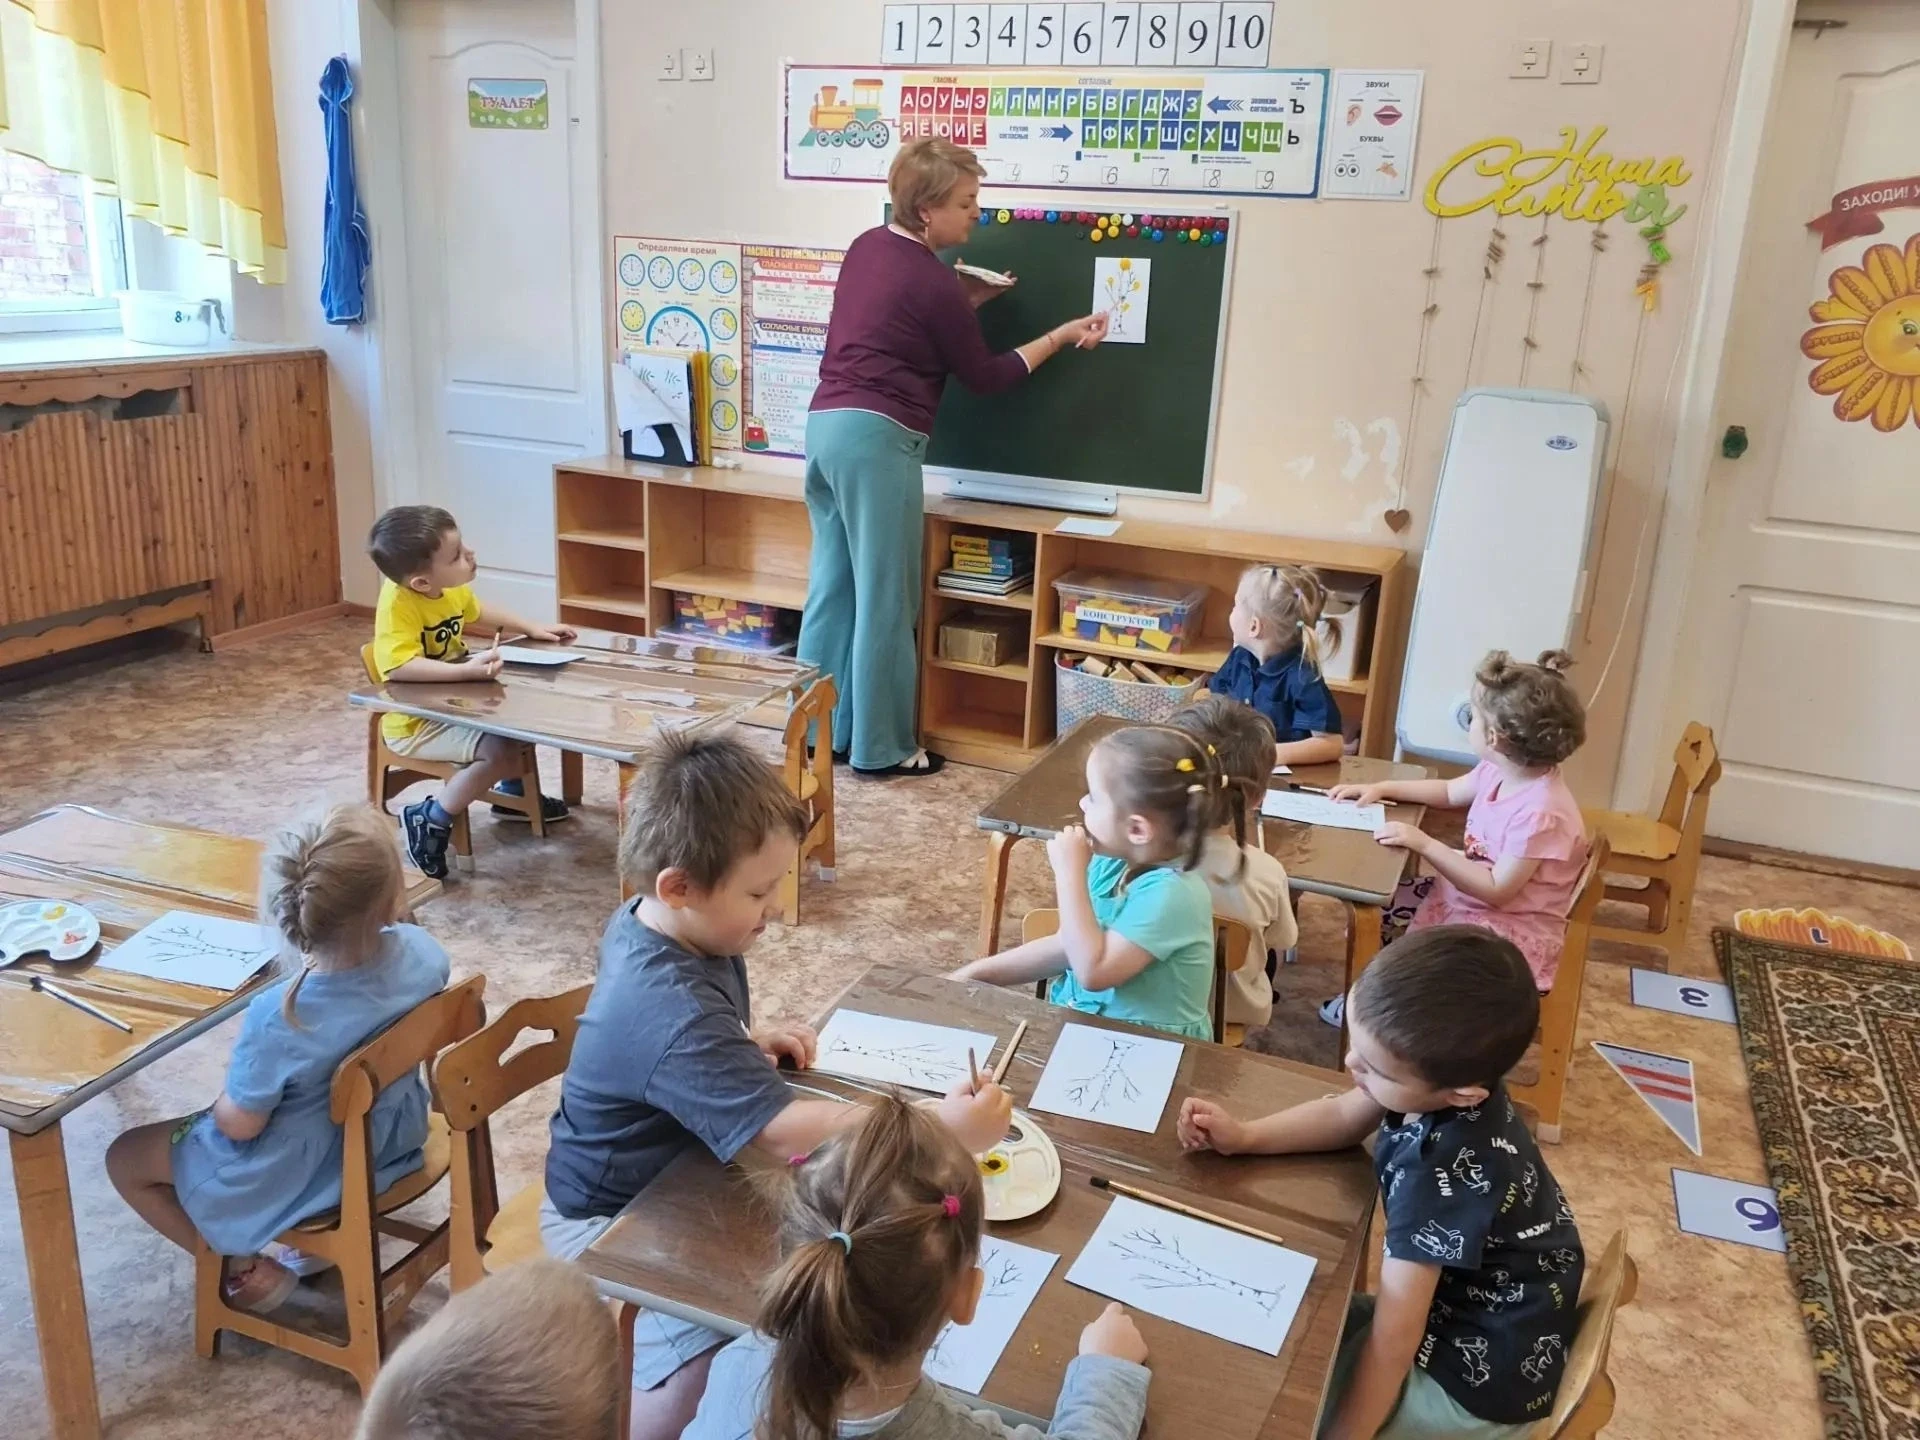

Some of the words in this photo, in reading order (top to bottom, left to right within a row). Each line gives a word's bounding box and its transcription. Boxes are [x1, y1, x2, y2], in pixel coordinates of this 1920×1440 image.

[895, 20, 905, 52] 1
[926, 16, 944, 48] 2
[964, 16, 981, 48] 3
[998, 16, 1016, 48] 4
[1036, 16, 1053, 48] 5
[1073, 20, 1092, 54] 6
[1112, 15, 1130, 48] 7
[1148, 15, 1166, 48] 8
[1187, 20, 1208, 54] 9
[1225, 14, 1265, 49] 10
[1840, 186, 1908, 211] ЗАХОДИ!
[638, 242, 688, 254] Определяем
[690, 246, 717, 255] время
[1083, 608, 1156, 627] КОНСТРУКТОР
